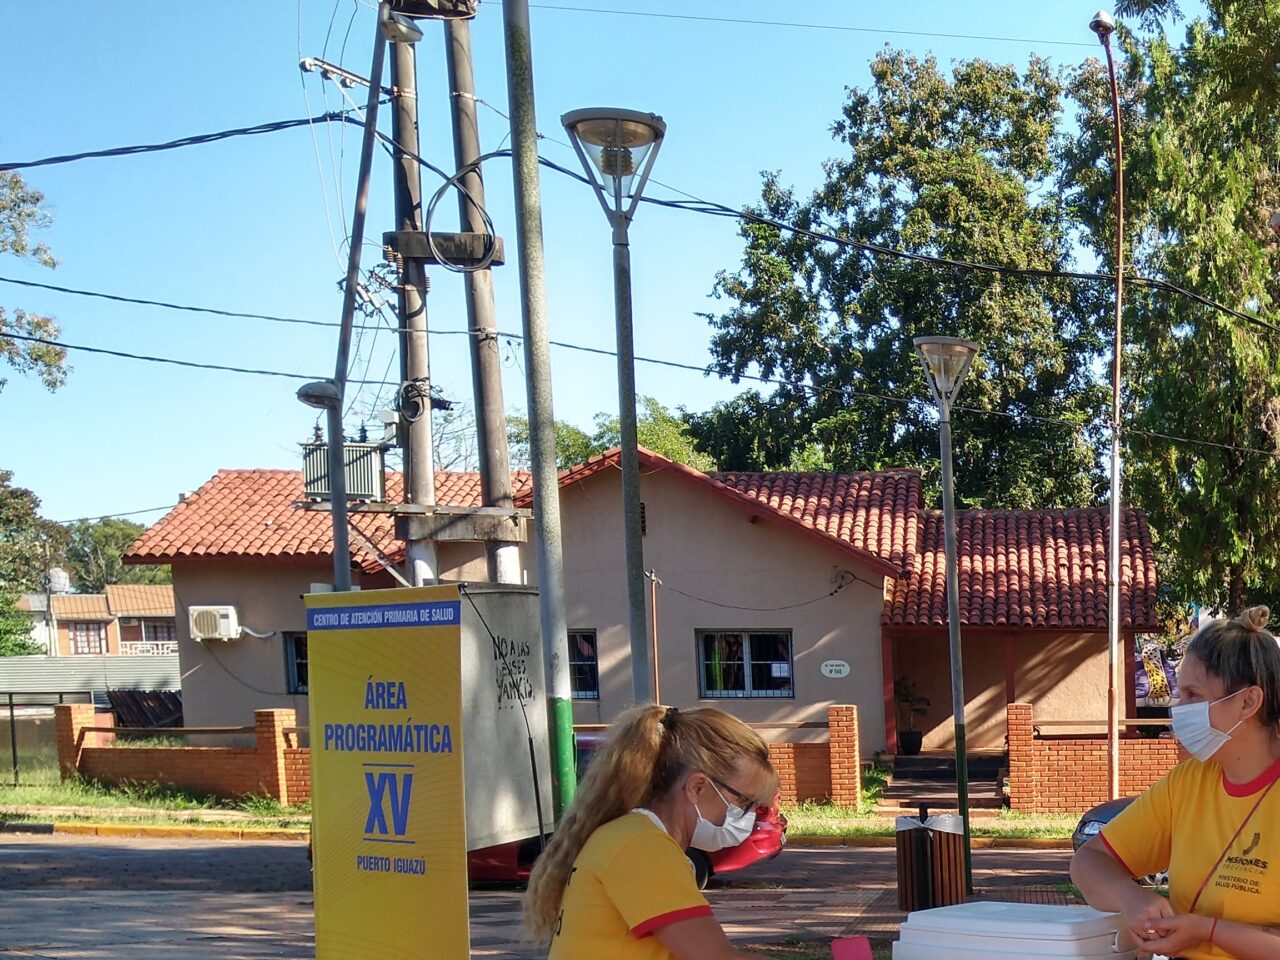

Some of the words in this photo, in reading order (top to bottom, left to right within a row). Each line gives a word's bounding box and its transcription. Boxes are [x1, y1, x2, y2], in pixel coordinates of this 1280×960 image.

[314, 614, 338, 626] CENTRO
[340, 613, 350, 625] DE
[351, 609, 382, 624] ATENCIÓN
[384, 610, 418, 623] PRIMARIA
[420, 609, 430, 622] DE
[432, 608, 454, 621] SALUD
[364, 674, 408, 710] ÁREA
[324, 717, 452, 754] PROGRAMÁTICA
[364, 772, 413, 836] XV
[357, 855, 390, 873] PUERTO
[393, 856, 426, 875] IGUAZÚ
[1226, 856, 1269, 869] MISIONES
[1218, 874, 1248, 885] MINISTERIO
